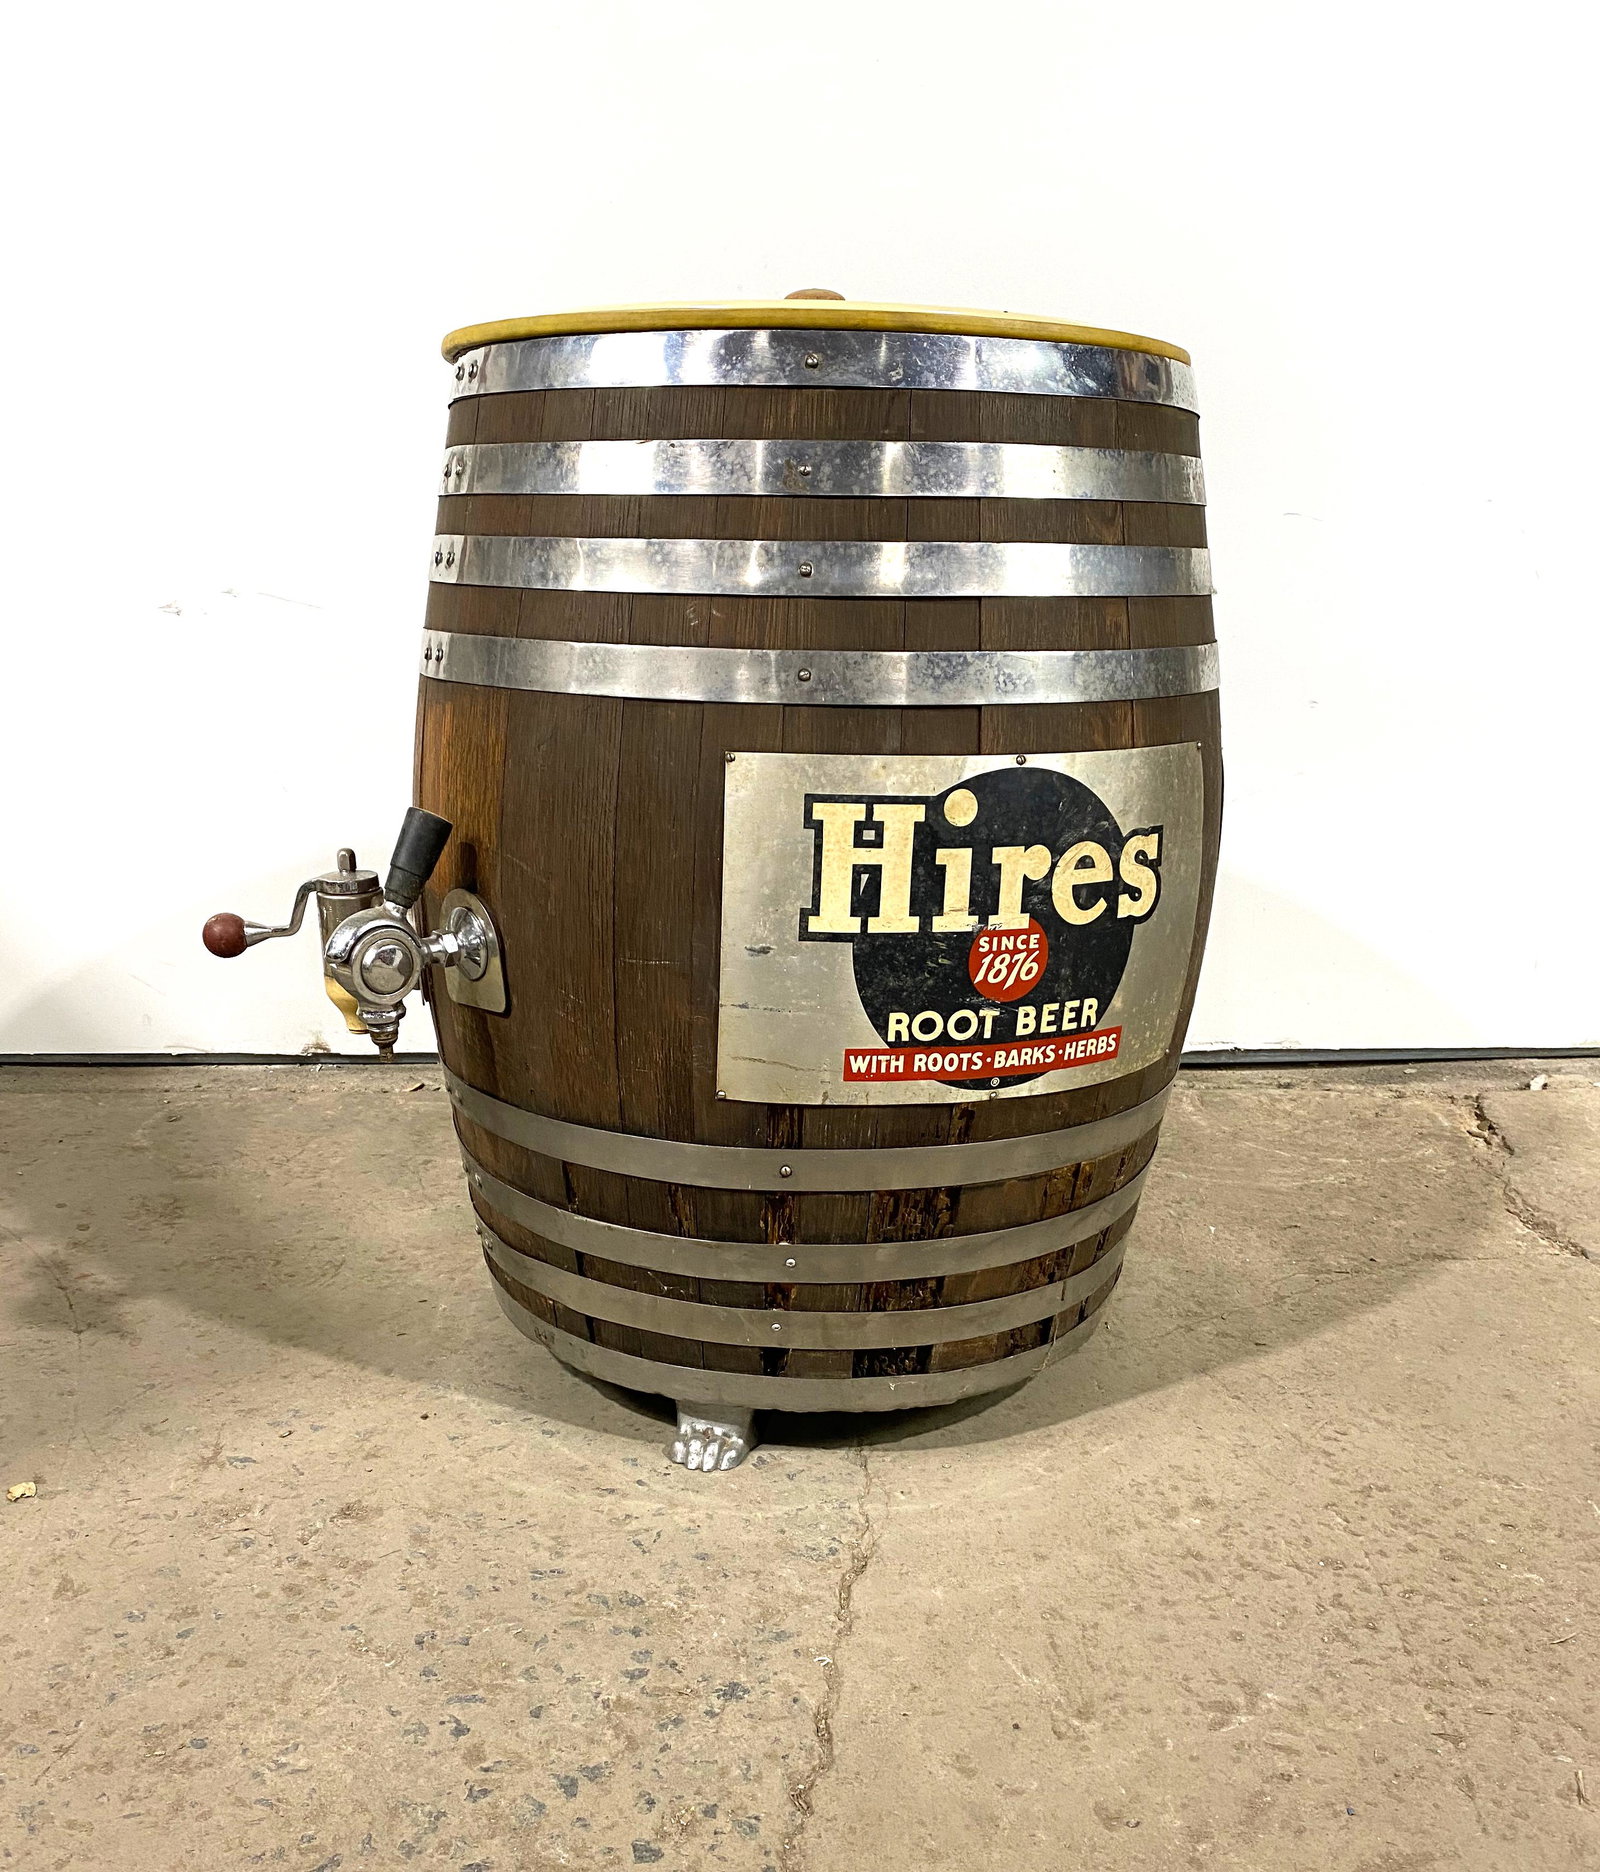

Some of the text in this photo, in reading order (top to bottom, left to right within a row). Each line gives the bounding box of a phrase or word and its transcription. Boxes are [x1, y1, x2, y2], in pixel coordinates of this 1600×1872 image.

[806, 788, 1161, 934] Hires
[977, 933, 1040, 952] SINCE
[974, 951, 1040, 991] 1876
[887, 997, 1098, 1043] ROOT BEER
[849, 1054, 905, 1075] WITH
[913, 1052, 983, 1073] ROOTS
